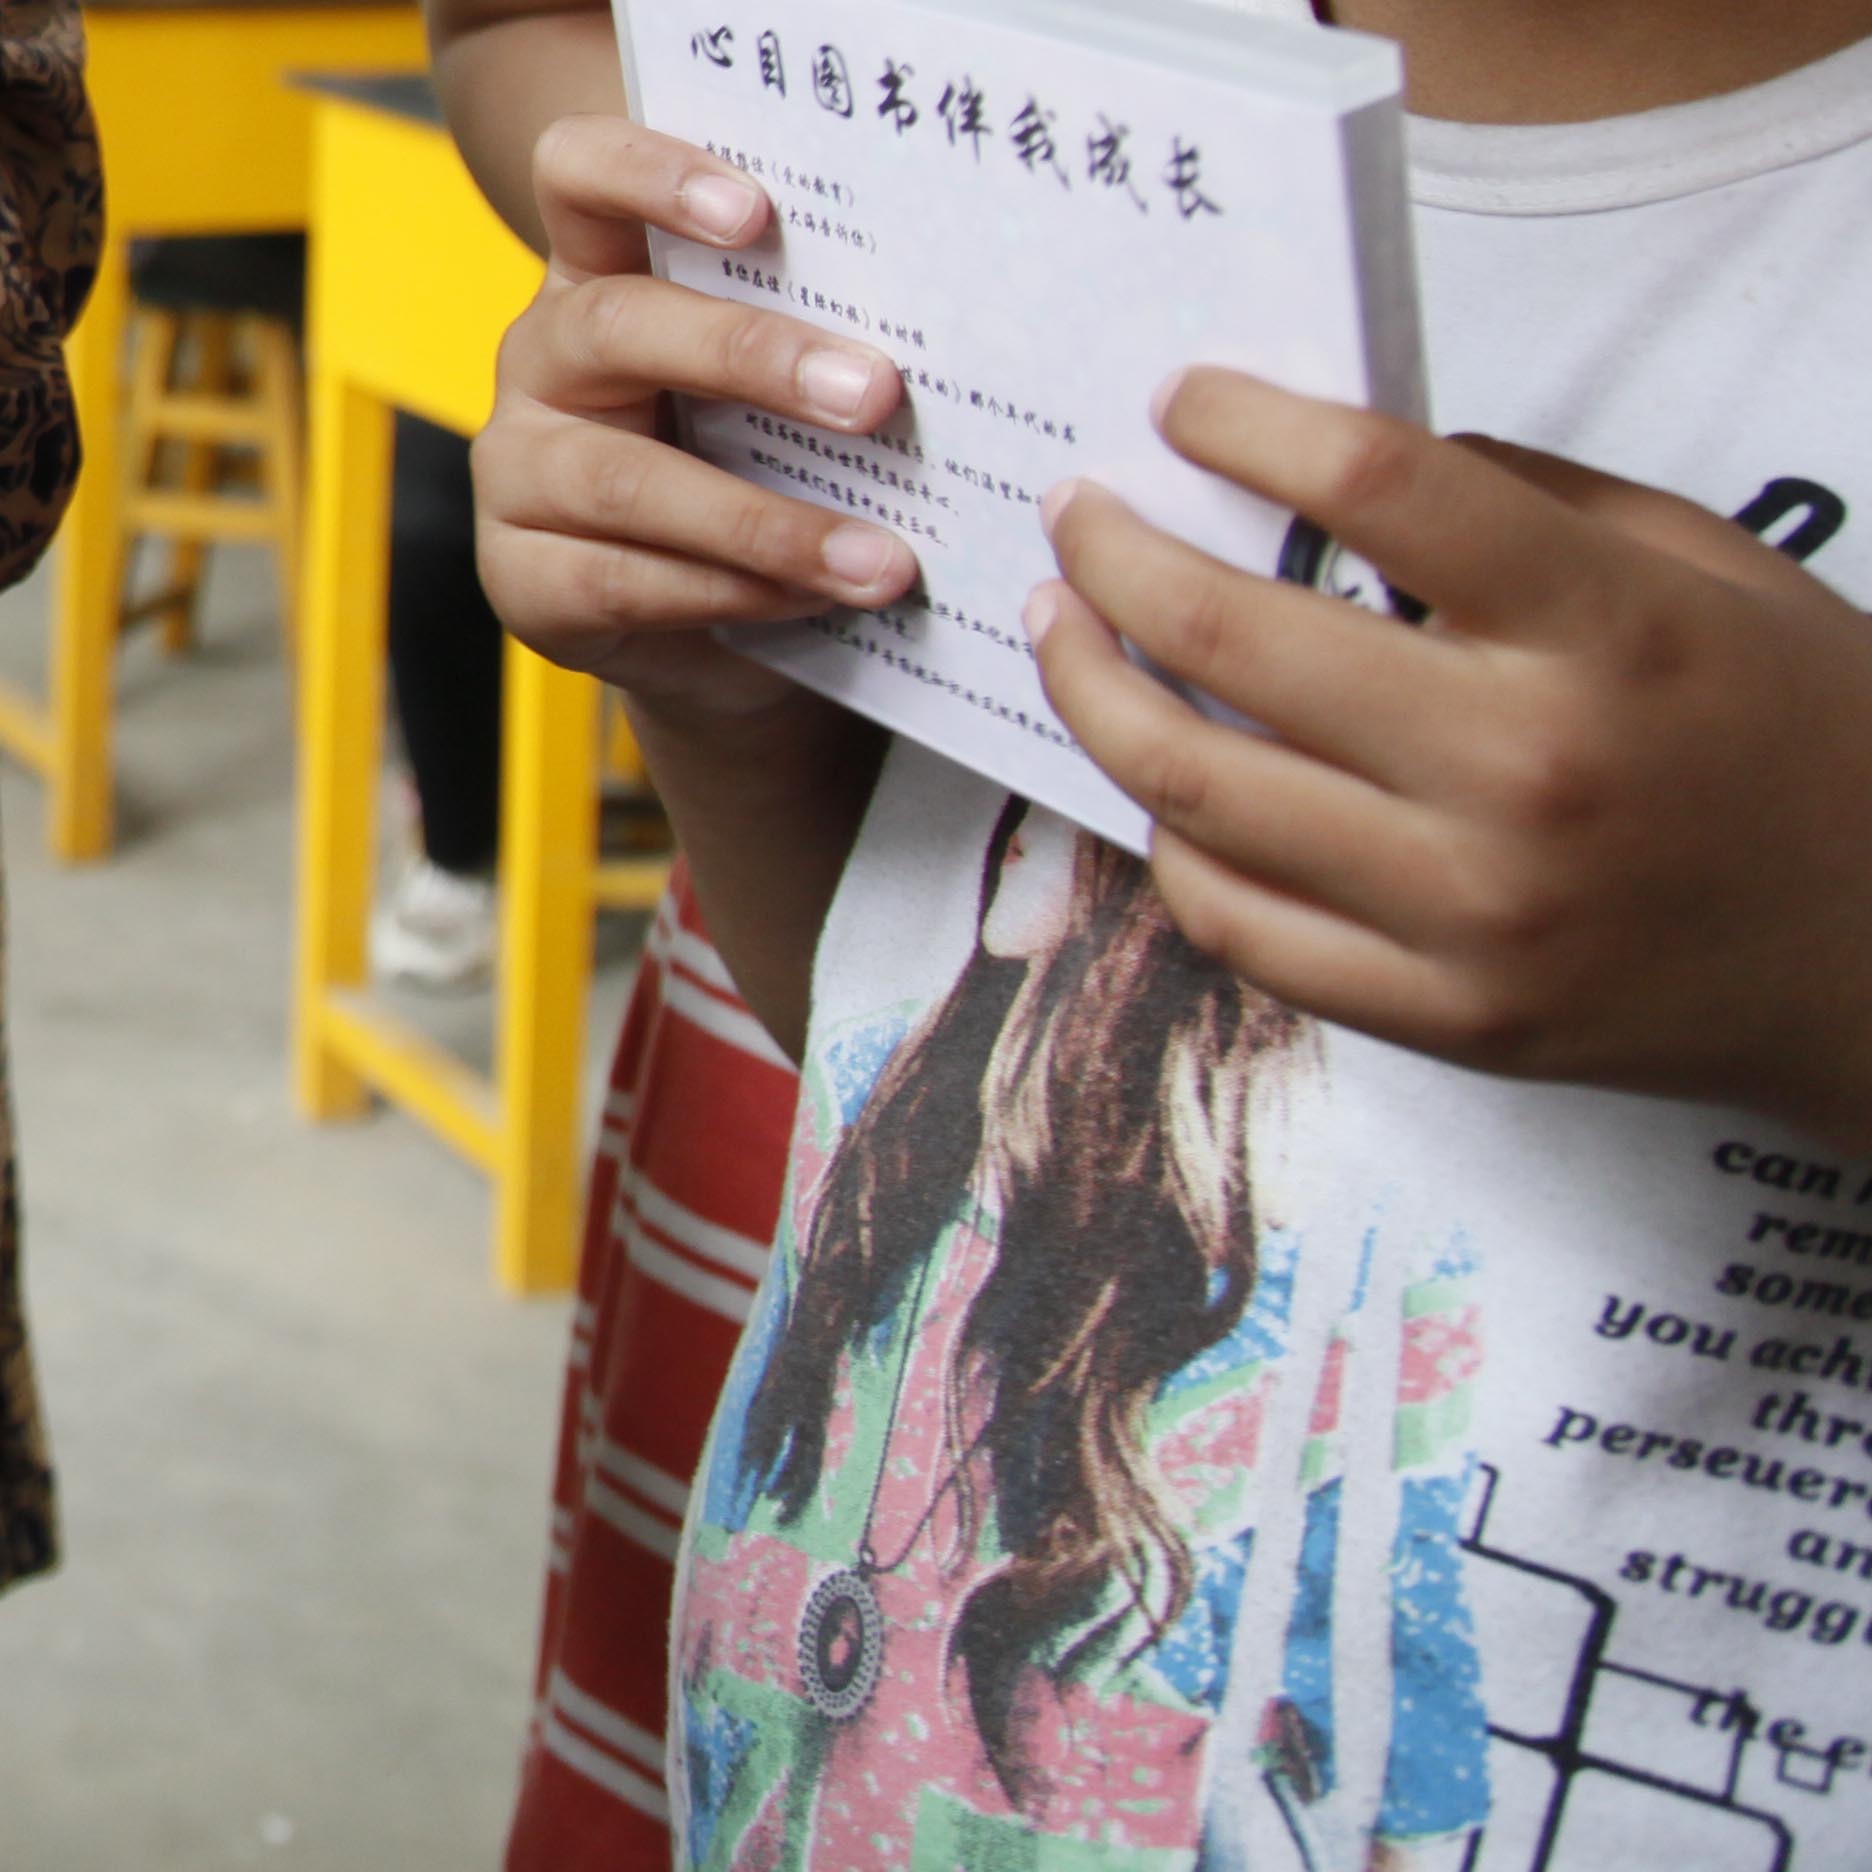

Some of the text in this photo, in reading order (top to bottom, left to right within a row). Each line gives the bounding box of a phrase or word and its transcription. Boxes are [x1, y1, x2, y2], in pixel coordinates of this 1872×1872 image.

[691, 24, 1226, 221] 心目图书伴我成长
[1713, 1140, 1842, 1200] can
[1594, 1293, 1737, 1361] you
[1690, 1686, 1806, 1752] the
